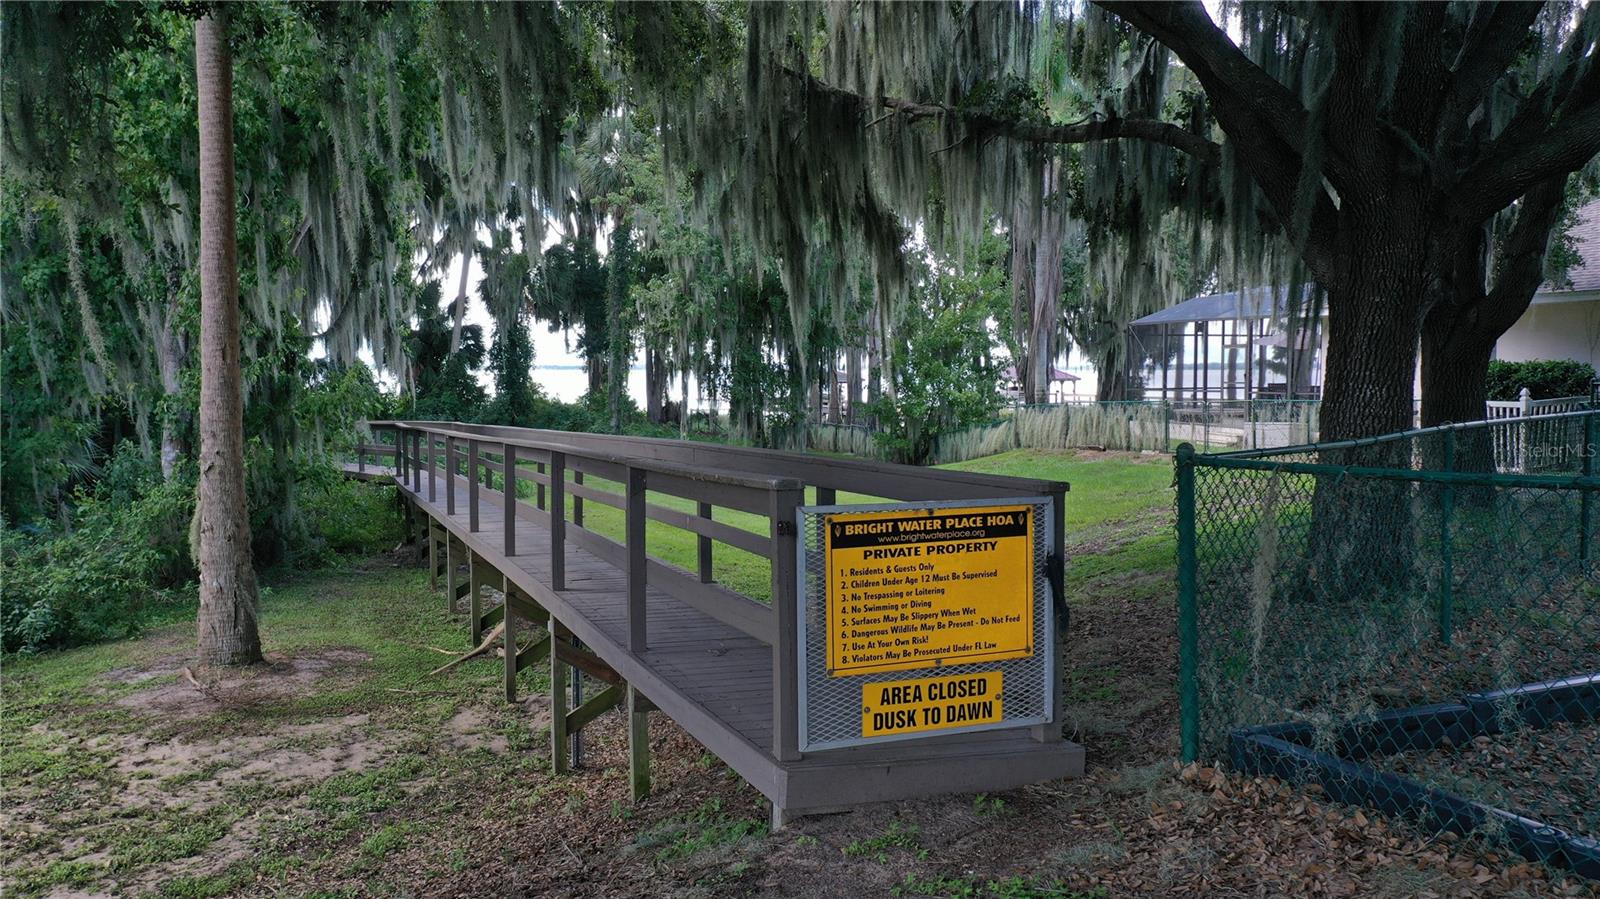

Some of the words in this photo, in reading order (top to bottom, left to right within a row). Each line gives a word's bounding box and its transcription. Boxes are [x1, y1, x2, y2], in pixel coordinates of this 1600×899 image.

[845, 522, 894, 536] BRIGHT
[898, 520, 942, 532] WATER
[946, 516, 983, 528] PLACE
[987, 515, 1014, 526] HOA
[878, 530, 986, 542] www.brightwaterplace.org
[864, 546, 921, 560] PRIVATE
[926, 541, 998, 555] PROPERTY
[840, 569, 848, 577] 1.
[850, 568, 884, 576] Residents
[886, 566, 892, 574] &
[894, 564, 916, 573] Guests
[918, 563, 934, 572] Only
[841, 581, 848, 590] 2.
[851, 580, 880, 589] Children
[882, 577, 903, 586] Under
[905, 576, 918, 585] Age
[922, 574, 930, 582] 12
[932, 573, 950, 582] Must
[952, 572, 960, 580] Be
[962, 569, 998, 580] Supervised
[841, 594, 848, 602] 3.
[851, 592, 862, 601] No
[864, 590, 904, 600] Trespassing
[915, 587, 945, 596] Loitering
[842, 619, 849, 627] 5.
[852, 617, 880, 626] Surfaces
[882, 614, 898, 623] May
[912, 612, 938, 620] Slippery
[940, 609, 960, 617] When
[962, 607, 976, 615] Wet
[852, 606, 862, 614] No
[864, 603, 898, 612] Swimming
[852, 629, 888, 638] Dangerous
[890, 624, 918, 634] Wildlife
[920, 624, 935, 632] May
[937, 622, 946, 630] Be
[948, 620, 974, 628] Present
[980, 618, 990, 626] Do
[1006, 614, 1020, 622] Feed
[842, 656, 850, 664] 8.
[852, 654, 884, 662] Violators
[886, 652, 900, 660] May
[914, 645, 950, 656] Prosecuted
[952, 644, 972, 652] Under
[975, 642, 982, 650] FL
[852, 642, 865, 650] Use
[878, 640, 892, 648] Your
[912, 636, 928, 644] Risk!
[880, 684, 922, 706] AREA
[928, 678, 987, 700] CLOSED
[873, 709, 916, 731] DUSK
[922, 706, 941, 726] TO
[946, 701, 993, 723] DAWN
